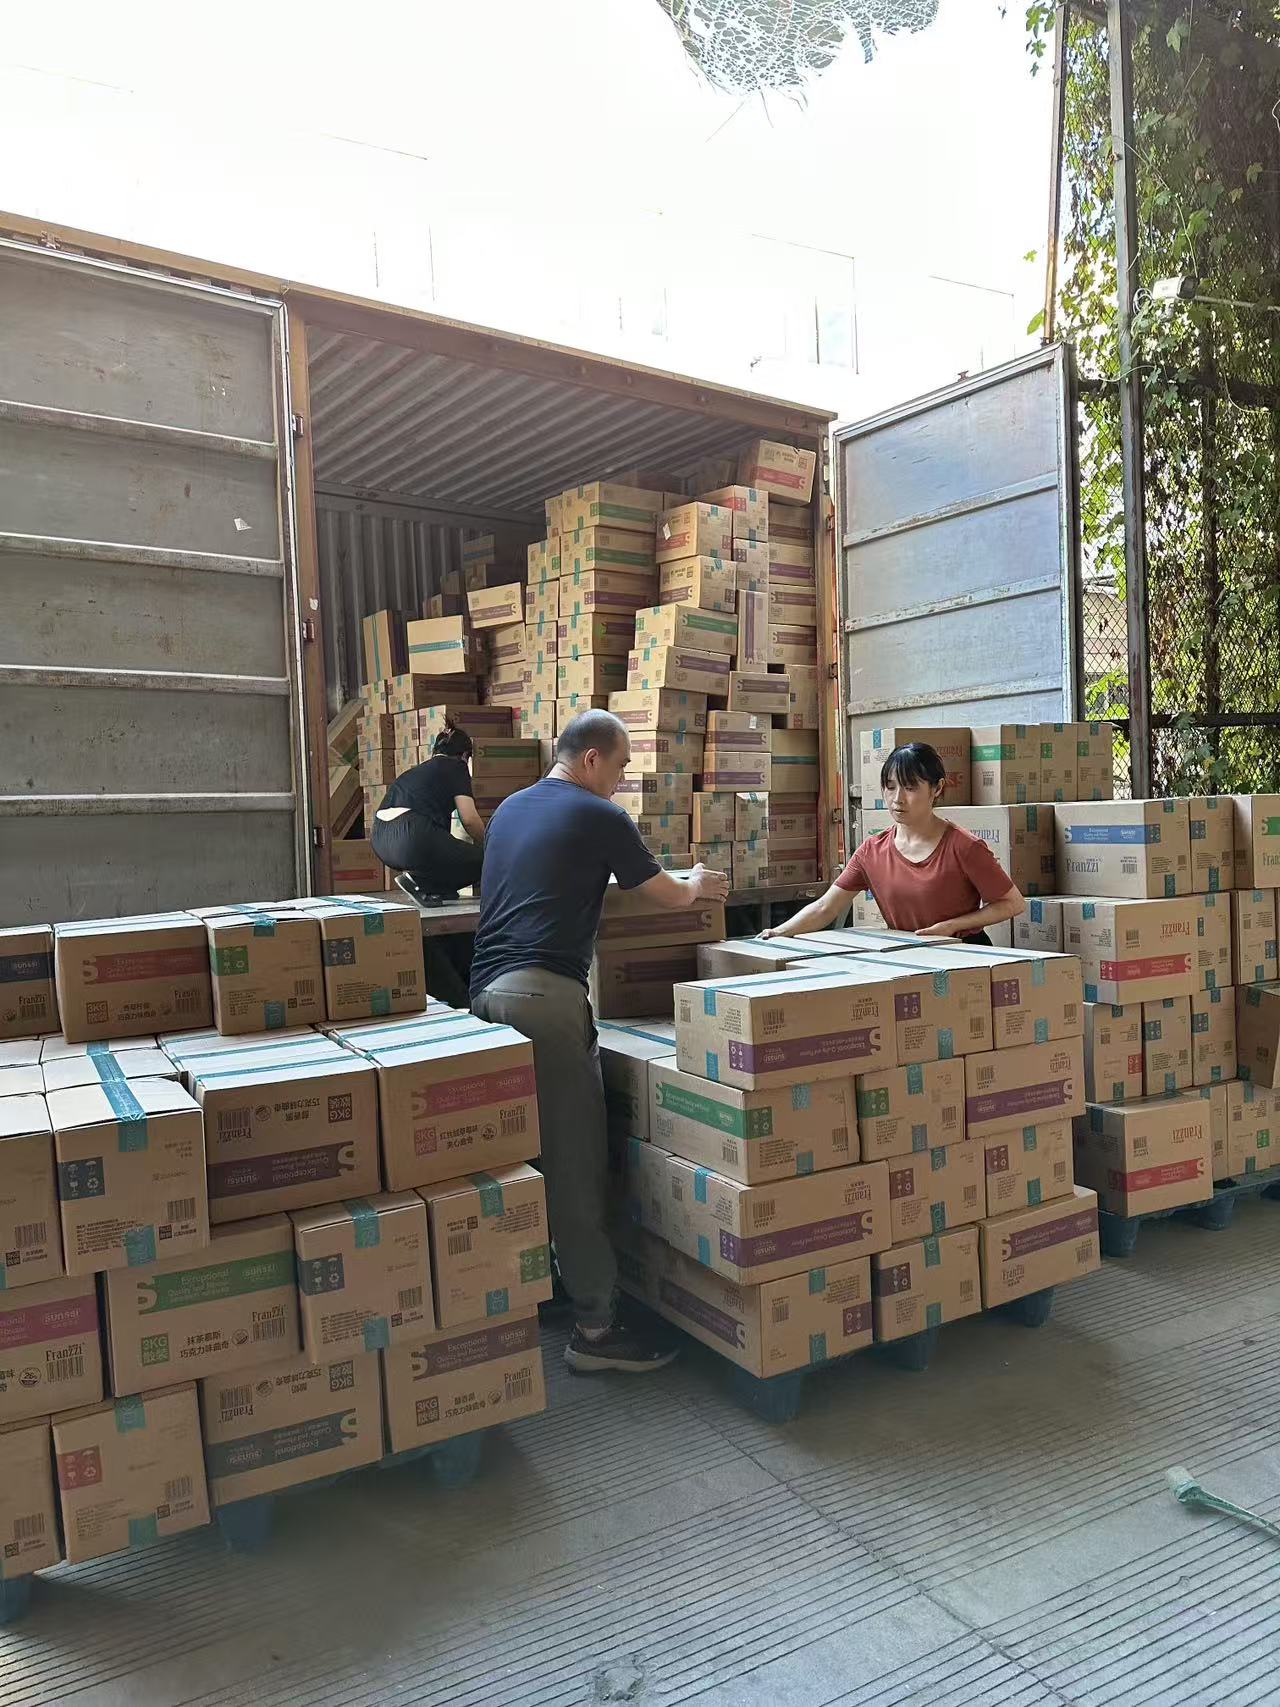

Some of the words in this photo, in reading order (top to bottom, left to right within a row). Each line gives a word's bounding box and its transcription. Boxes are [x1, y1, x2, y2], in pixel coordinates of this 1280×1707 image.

[1066, 859, 1099, 873] Franzzi
[1162, 921, 1190, 936] Franzzi
[852, 1006, 879, 1018] Franzzi
[329, 1107, 351, 1120] 3KG
[500, 1107, 526, 1120] Franzzi
[219, 1128, 252, 1141] Franzzi
[1172, 1124, 1202, 1140] Franzzi
[252, 1305, 286, 1322] Franzzi
[143, 1336, 168, 1350] 3KG
[180, 1341, 229, 1359] 巧克力味曲奇
[46, 1345, 83, 1362] Franzzi
[331, 1374, 353, 1390] 3KG
[504, 1367, 531, 1383] Franzzi
[222, 1404, 254, 1422] Franzzi
[416, 1399, 438, 1413] 3KG
